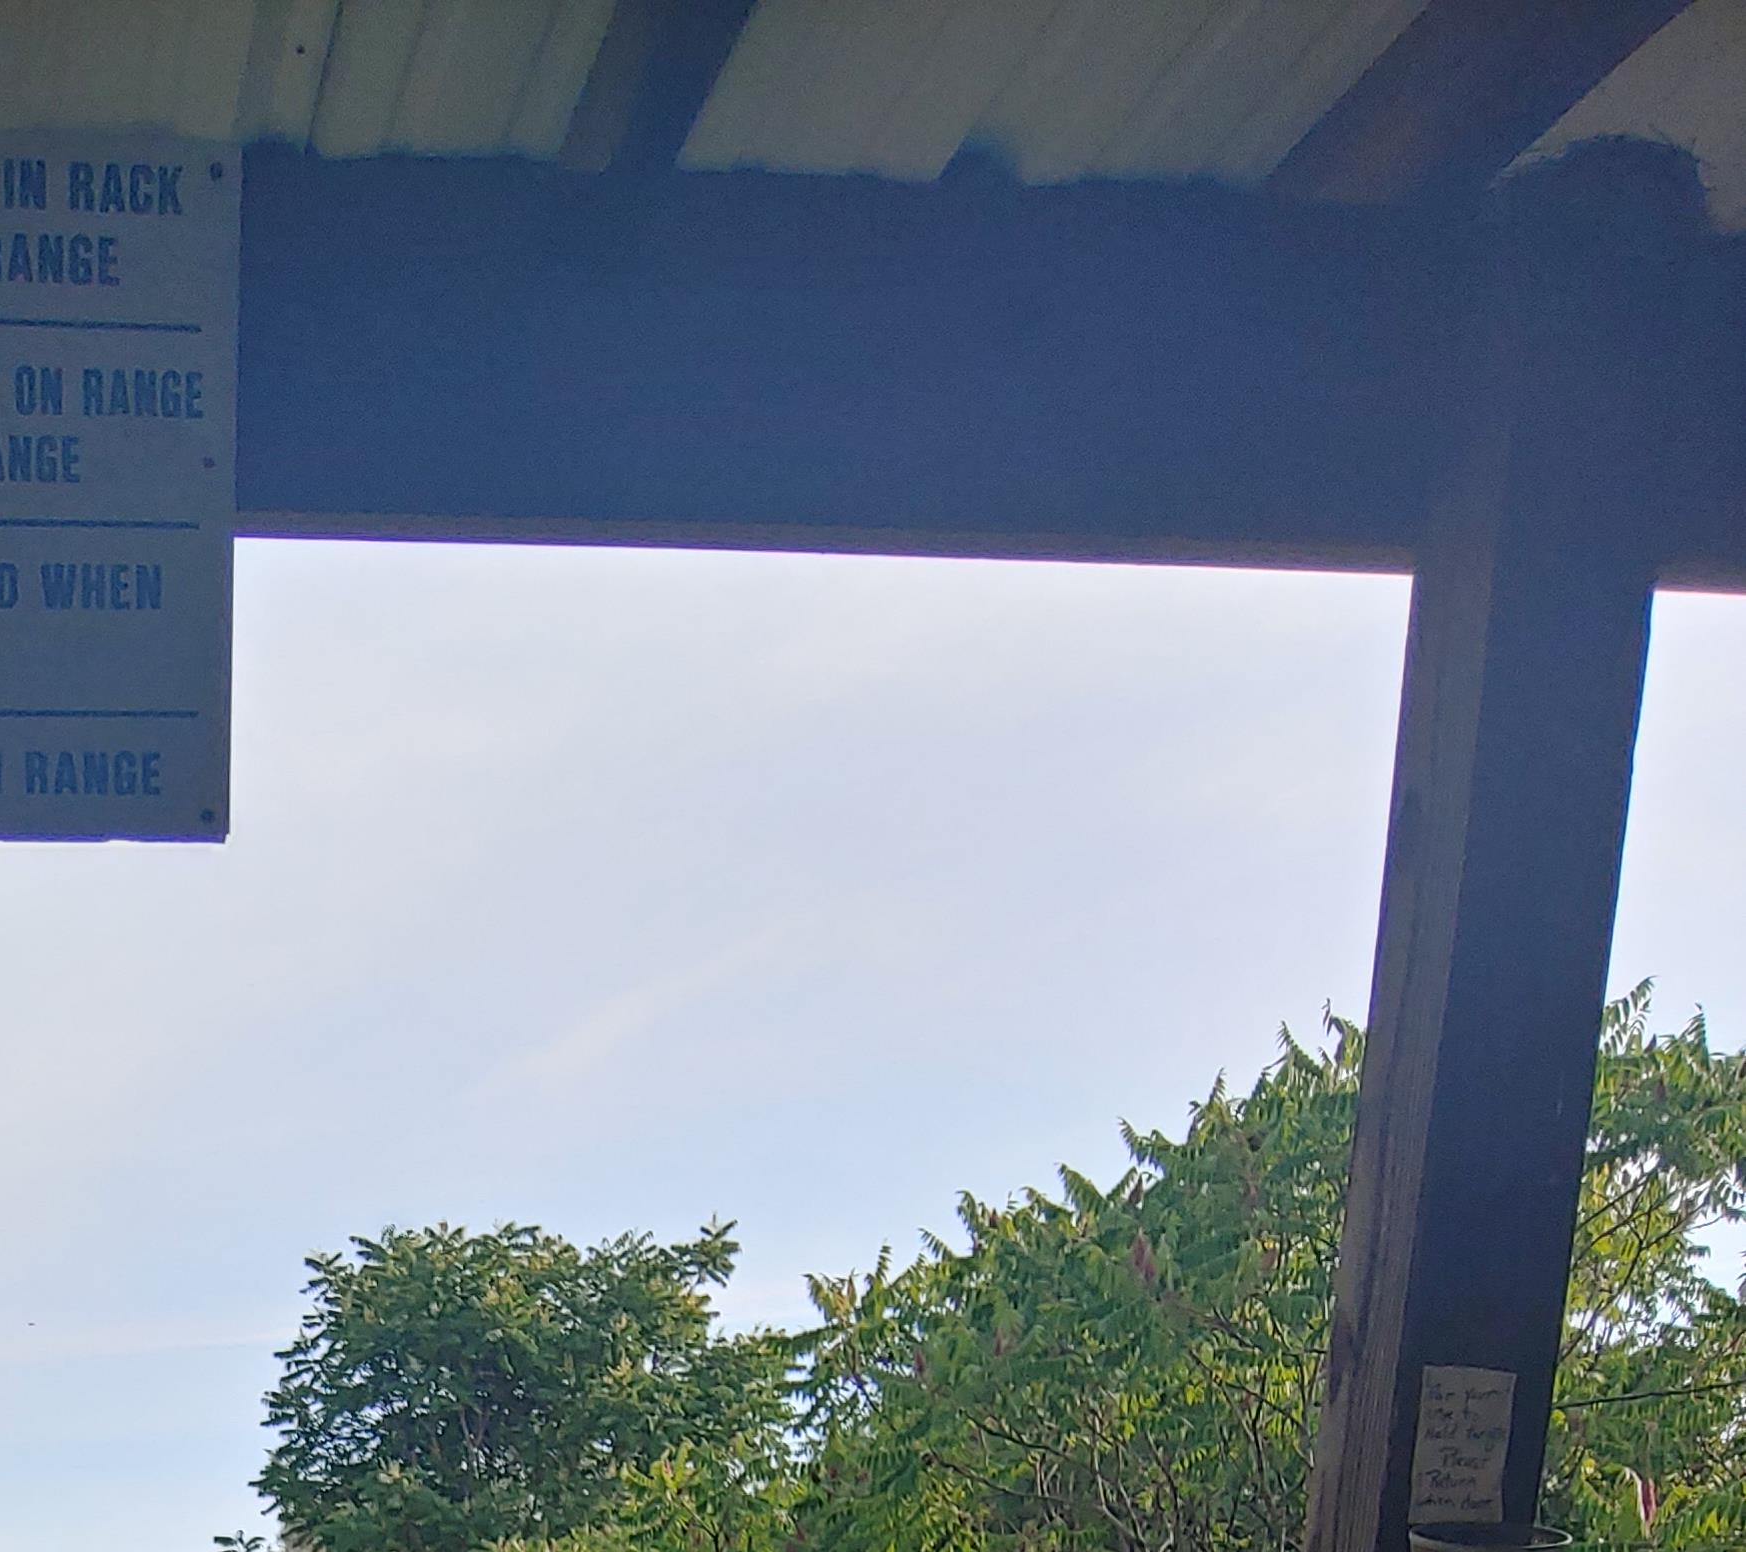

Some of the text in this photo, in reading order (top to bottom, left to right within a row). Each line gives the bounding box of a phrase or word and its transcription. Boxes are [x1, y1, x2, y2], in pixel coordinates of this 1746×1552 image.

[3, 157, 47, 211] IN
[68, 161, 183, 216] RACK
[13, 364, 64, 416] ON
[82, 367, 204, 420] RANGE
[40, 562, 163, 612] WHEN
[24, 751, 162, 798] RANGE
